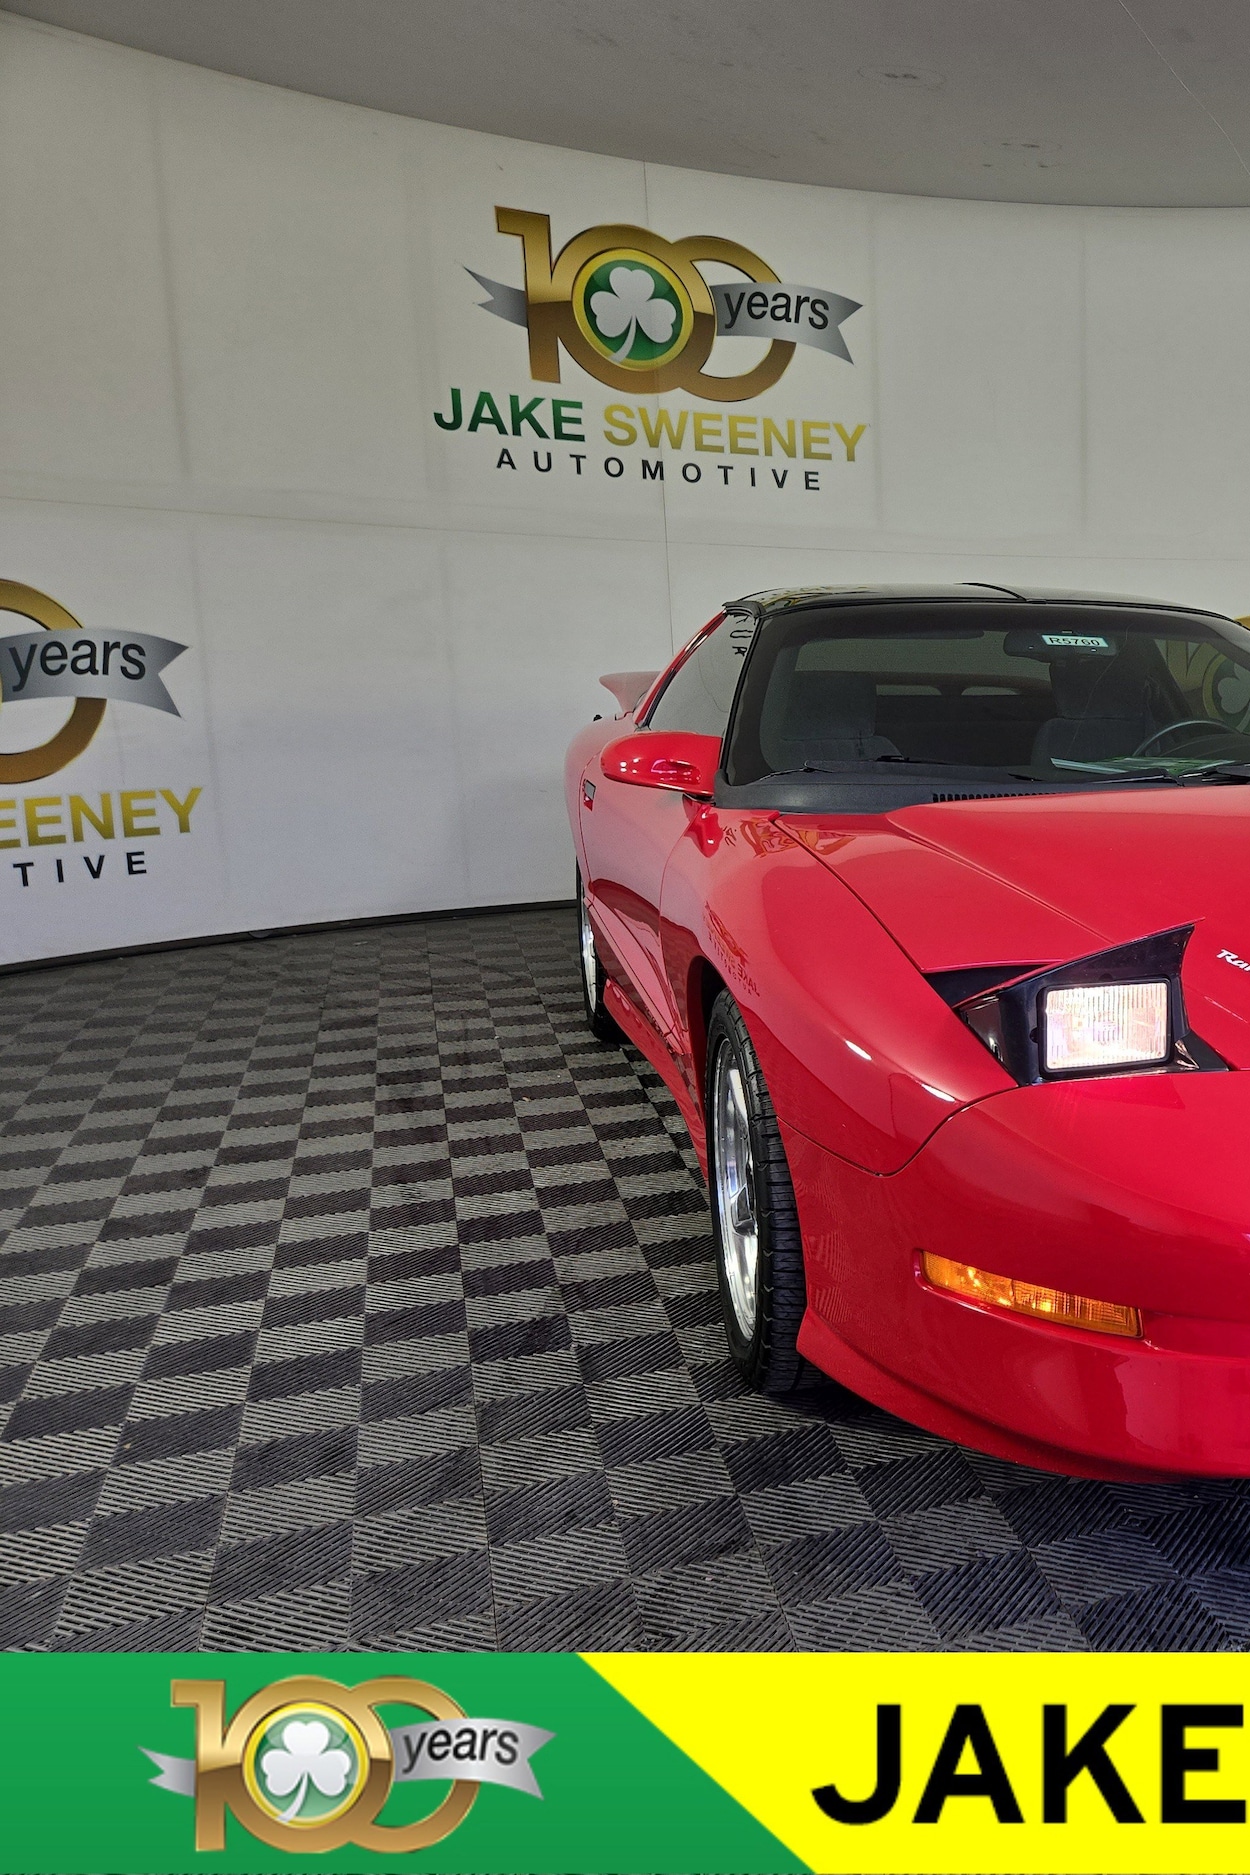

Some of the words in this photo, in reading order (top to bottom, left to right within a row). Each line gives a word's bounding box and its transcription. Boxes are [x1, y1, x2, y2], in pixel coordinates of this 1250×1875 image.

[724, 290, 830, 330] years
[433, 387, 586, 442] JAKE
[603, 404, 867, 462] SWEENEY
[496, 448, 821, 491] AUTOMOTIVE
[1048, 637, 1100, 646] R5760
[8, 639, 147, 692] years
